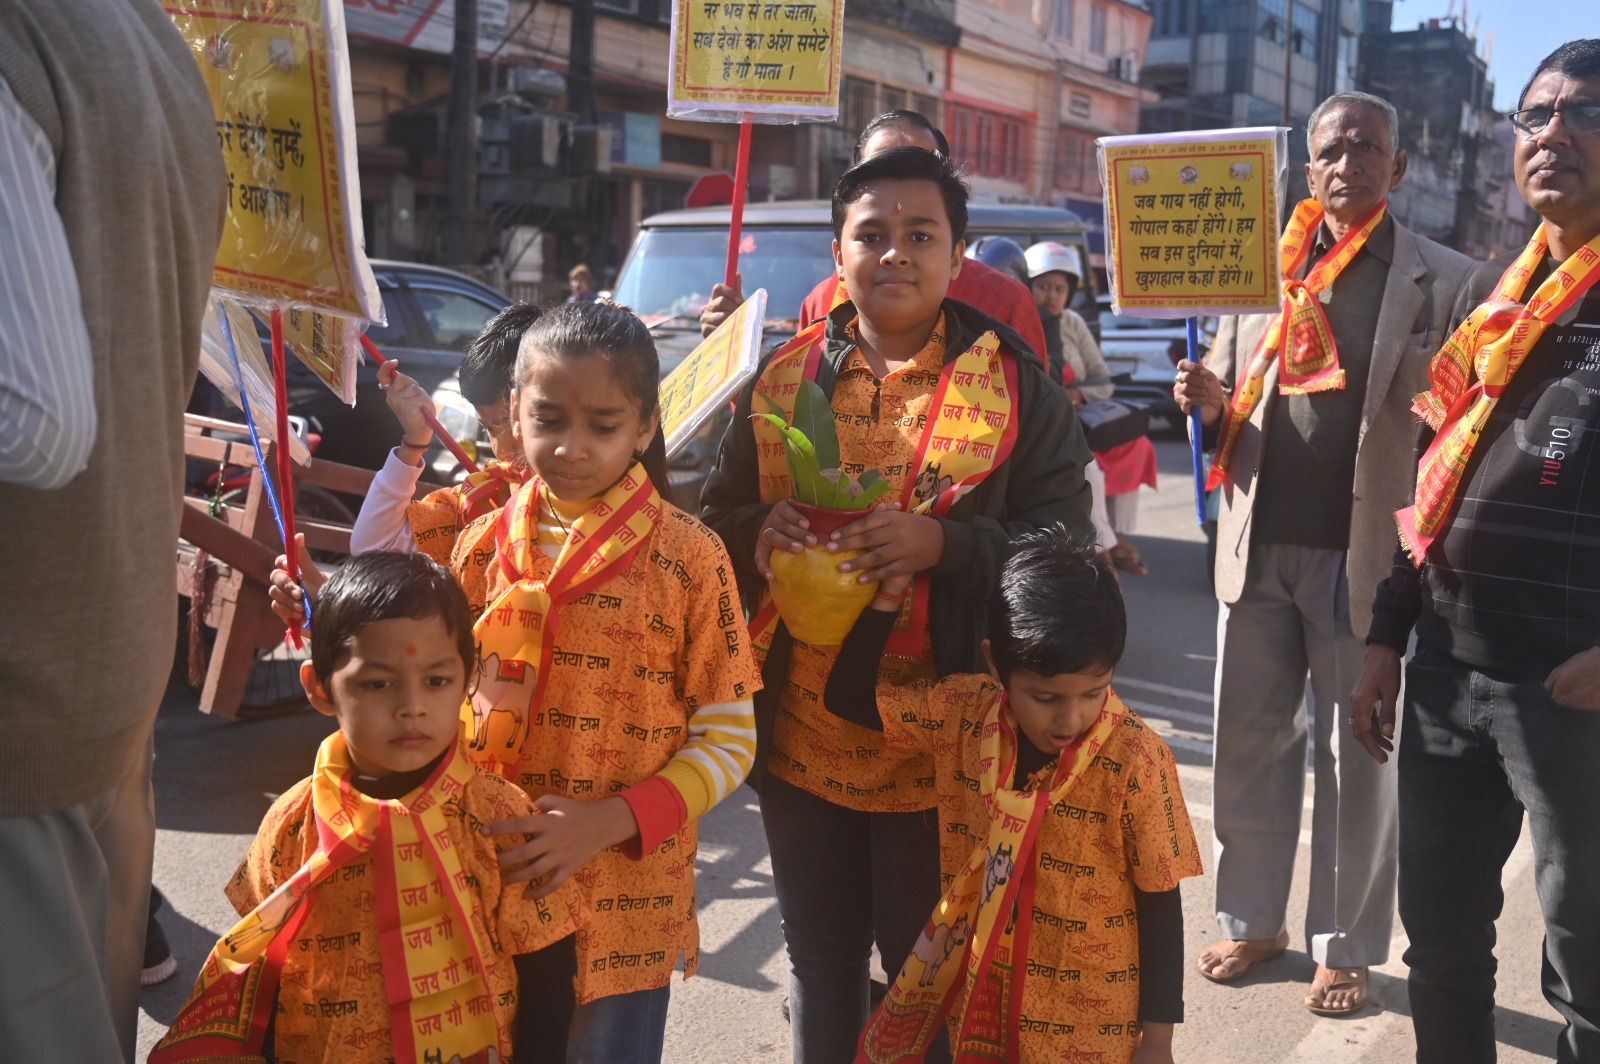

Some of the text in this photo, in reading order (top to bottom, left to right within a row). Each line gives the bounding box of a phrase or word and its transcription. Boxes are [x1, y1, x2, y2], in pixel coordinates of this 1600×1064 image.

[704, 3, 720, 20] नर
[724, 3, 743, 20] भव
[764, 4, 781, 21] तर
[784, 4, 817, 25] जाता,
[693, 32, 714, 49] सब
[745, 33, 764, 50] का
[767, 28, 793, 52] अंश
[797, 28, 830, 52] समेटे
[723, 55, 783, 81] है गौ माता
[1134, 186, 1245, 211] जब गाय नहीं होगी,
[1129, 215, 1169, 235] गोपाल
[1172, 215, 1200, 236] कहां
[1236, 218, 1256, 236] हम
[1140, 240, 1243, 266] सब इस दुनियां में,
[1135, 271, 1185, 291] खुशहाल
[1188, 266, 1215, 288] कहां
[901, 374, 925, 386] जय
[954, 371, 990, 390] जय गौ
[943, 402, 1006, 428] जय गौ माता
[932, 434, 994, 460] जय गौ माता
[844, 462, 865, 475] राम
[650, 550, 672, 571] जय
[598, 594, 622, 611] राम
[497, 601, 543, 631] गौ माता
[586, 655, 611, 671] राम
[579, 717, 600, 731] राम
[623, 723, 649, 742] जय
[1102, 757, 1122, 776] राम
[521, 773, 593, 793] जय राम
[823, 777, 843, 792] जय
[846, 782, 874, 797] सिया
[913, 776, 935, 789] जय
[1053, 800, 1107, 825] सिया राम
[397, 841, 423, 863] जय
[1040, 852, 1095, 878] सिया राम
[401, 885, 428, 907] जय
[596, 893, 673, 912] जय सिया राम
[1032, 906, 1063, 929] सिया
[1065, 920, 1087, 933] राम
[1104, 915, 1124, 929] जय
[405, 913, 454, 950] जय गौ
[591, 951, 665, 973] जय सिया राम
[1027, 958, 1057, 980] सिया
[1059, 969, 1081, 982] राम
[1106, 970, 1127, 984] जय
[413, 971, 440, 995] जय
[442, 957, 460, 985] गौ
[415, 1013, 442, 1036] जय
[445, 1000, 463, 1027] गौ
[1052, 1023, 1075, 1036] राम
[1098, 1024, 1123, 1036] जय
